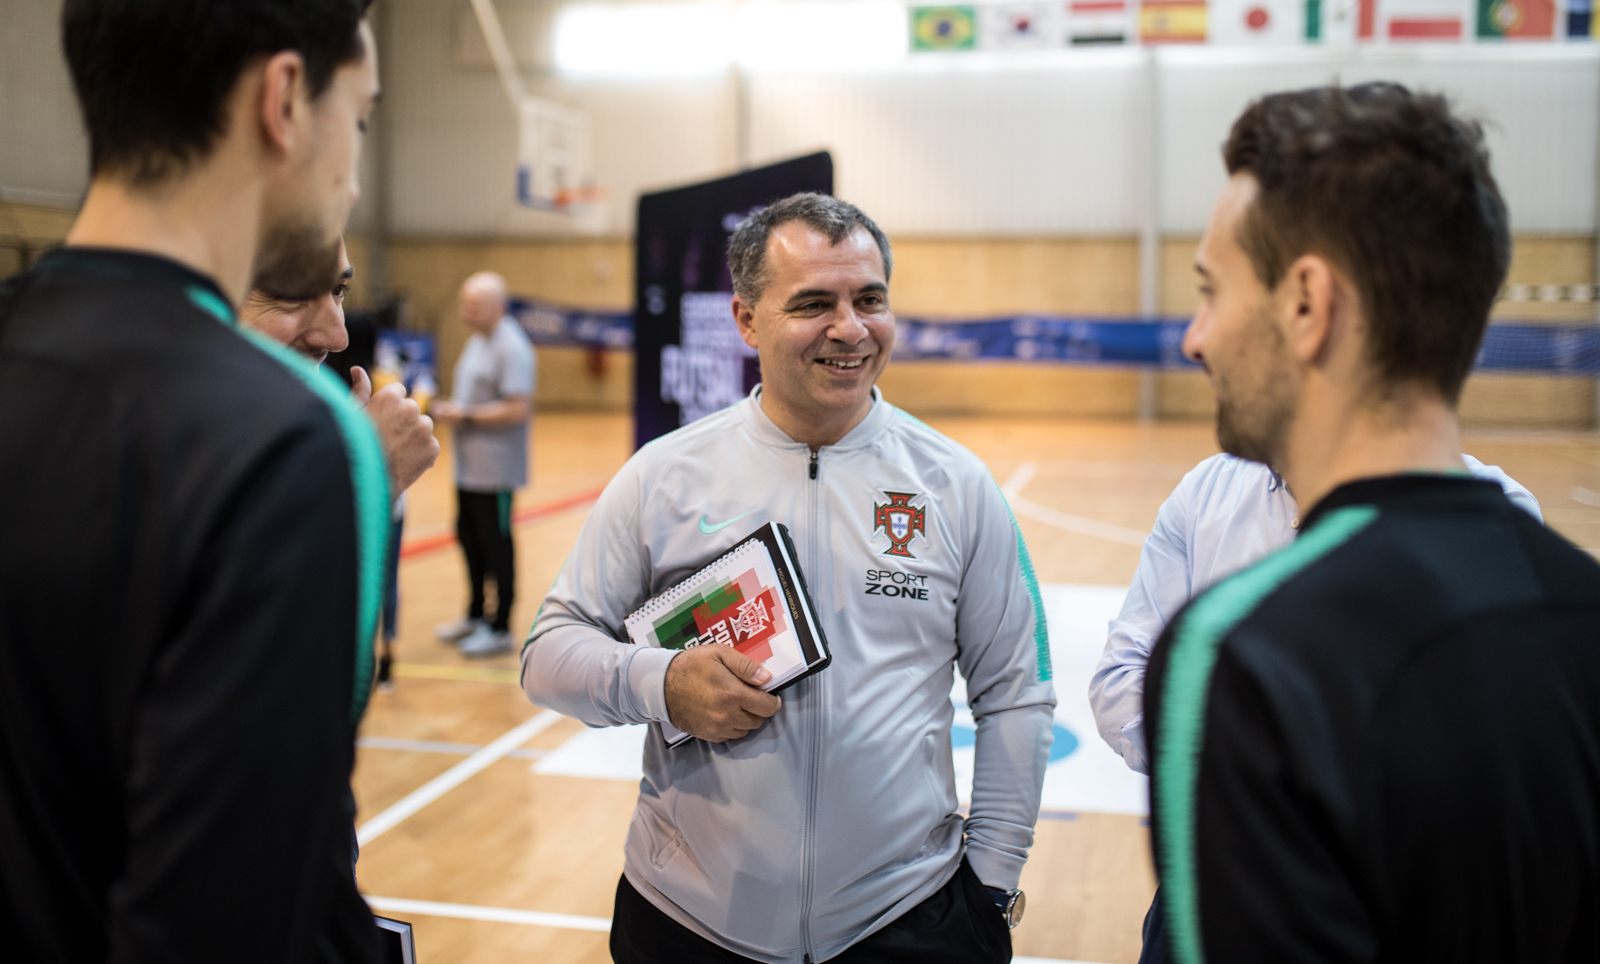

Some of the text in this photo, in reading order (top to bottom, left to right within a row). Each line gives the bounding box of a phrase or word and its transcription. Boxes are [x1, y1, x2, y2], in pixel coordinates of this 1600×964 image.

[866, 569, 928, 587] SPORT
[777, 567, 799, 620] MIGUEL HENRIQUES
[865, 582, 929, 601] ZONE
